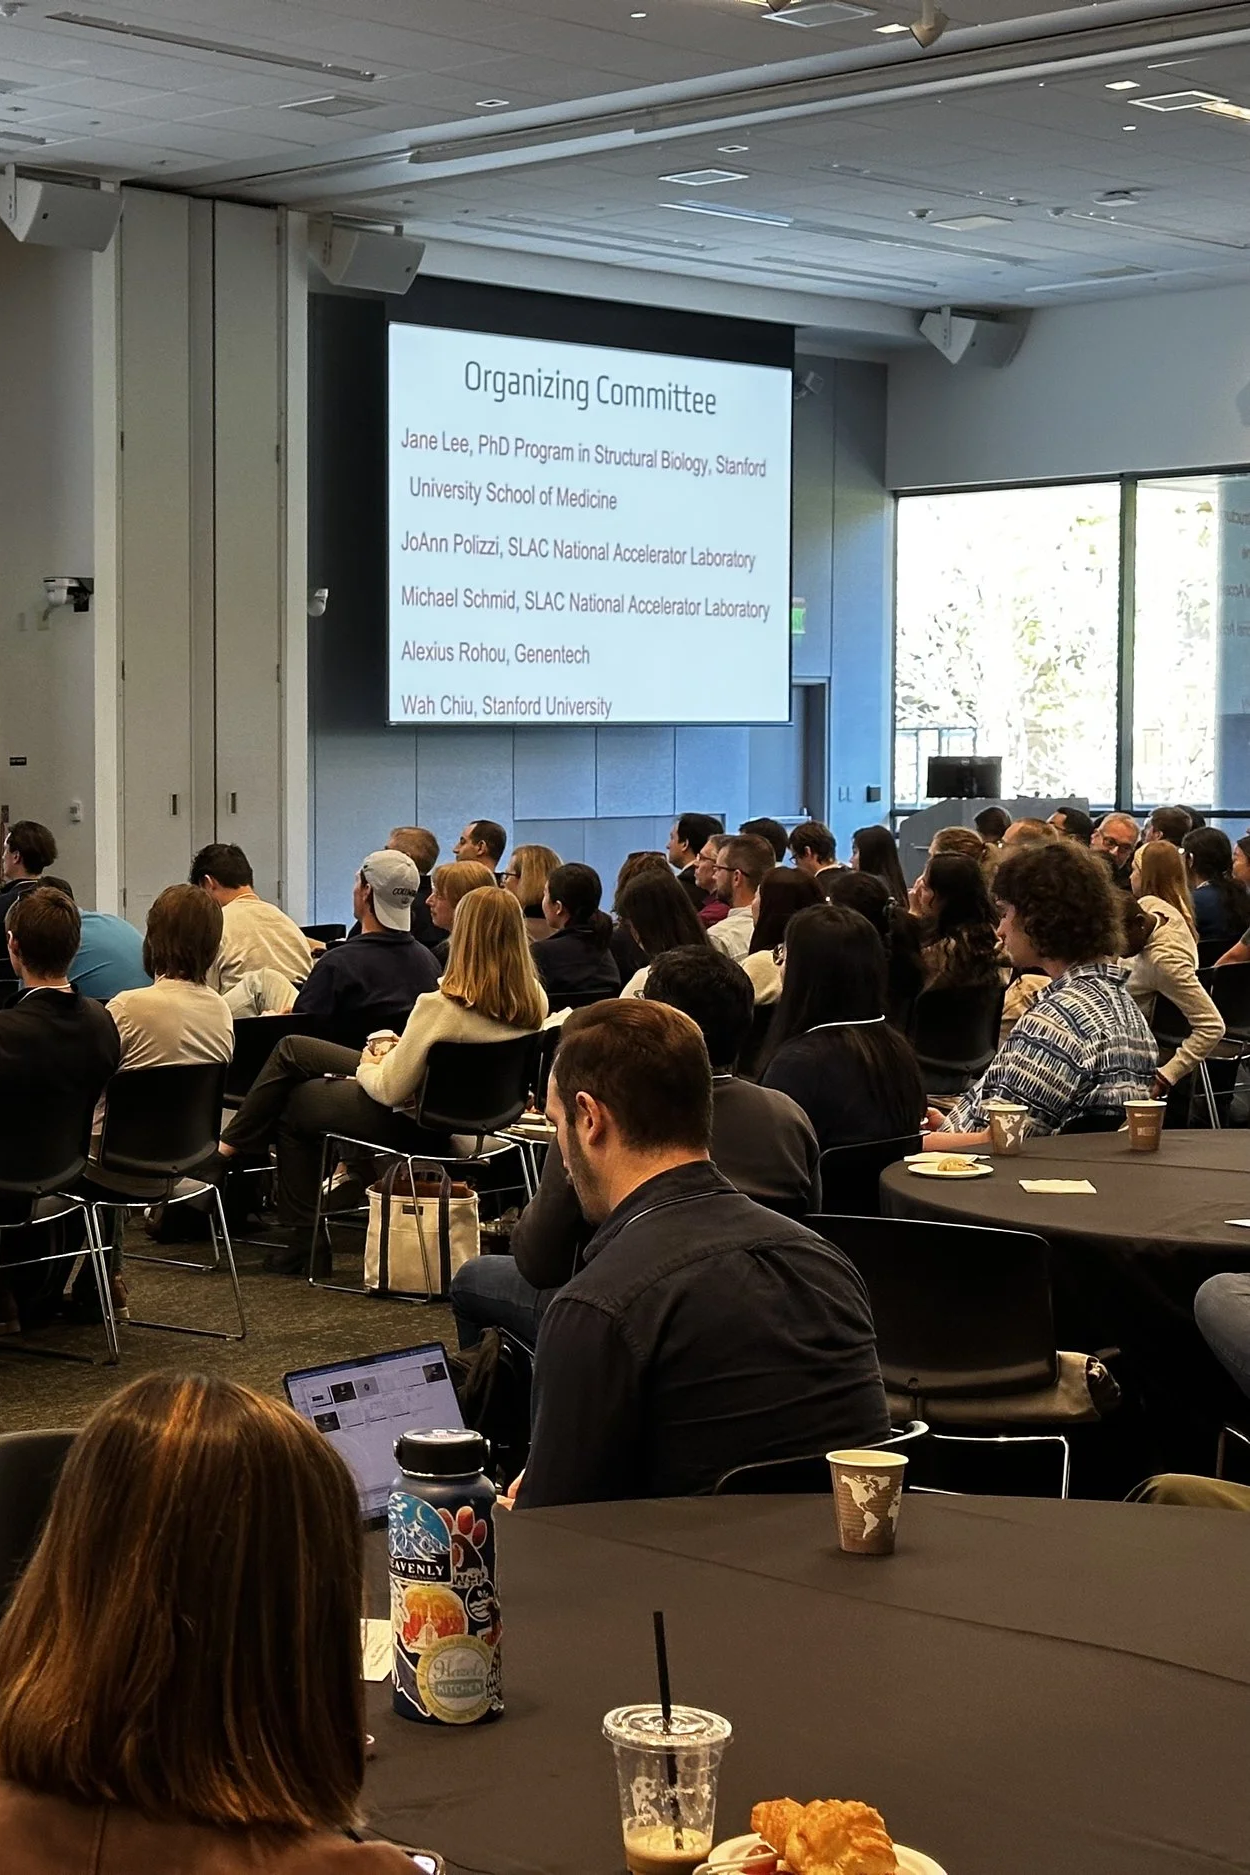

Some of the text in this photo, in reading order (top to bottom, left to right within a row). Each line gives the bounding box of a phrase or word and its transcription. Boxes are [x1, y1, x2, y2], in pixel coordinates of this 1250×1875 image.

[465, 361, 716, 415] Organizing Committee
[401, 427, 766, 478] Jane Lee, PhD Program in Structural Biology, Stanford
[410, 476, 617, 510] University School of Medicine
[401, 530, 756, 573] JoAnn Polizzi, SLAC National Accelerator Laboratory
[402, 585, 770, 623] Michael Schmid, SLAC National Accelerator Laboratory
[401, 640, 590, 666] Alexius Rohou, Genentech
[401, 694, 612, 719] Wah Chiu, Stanford University
[390, 1560, 444, 1576] EAVENLY
[437, 1683, 482, 1695] KITCHEN
